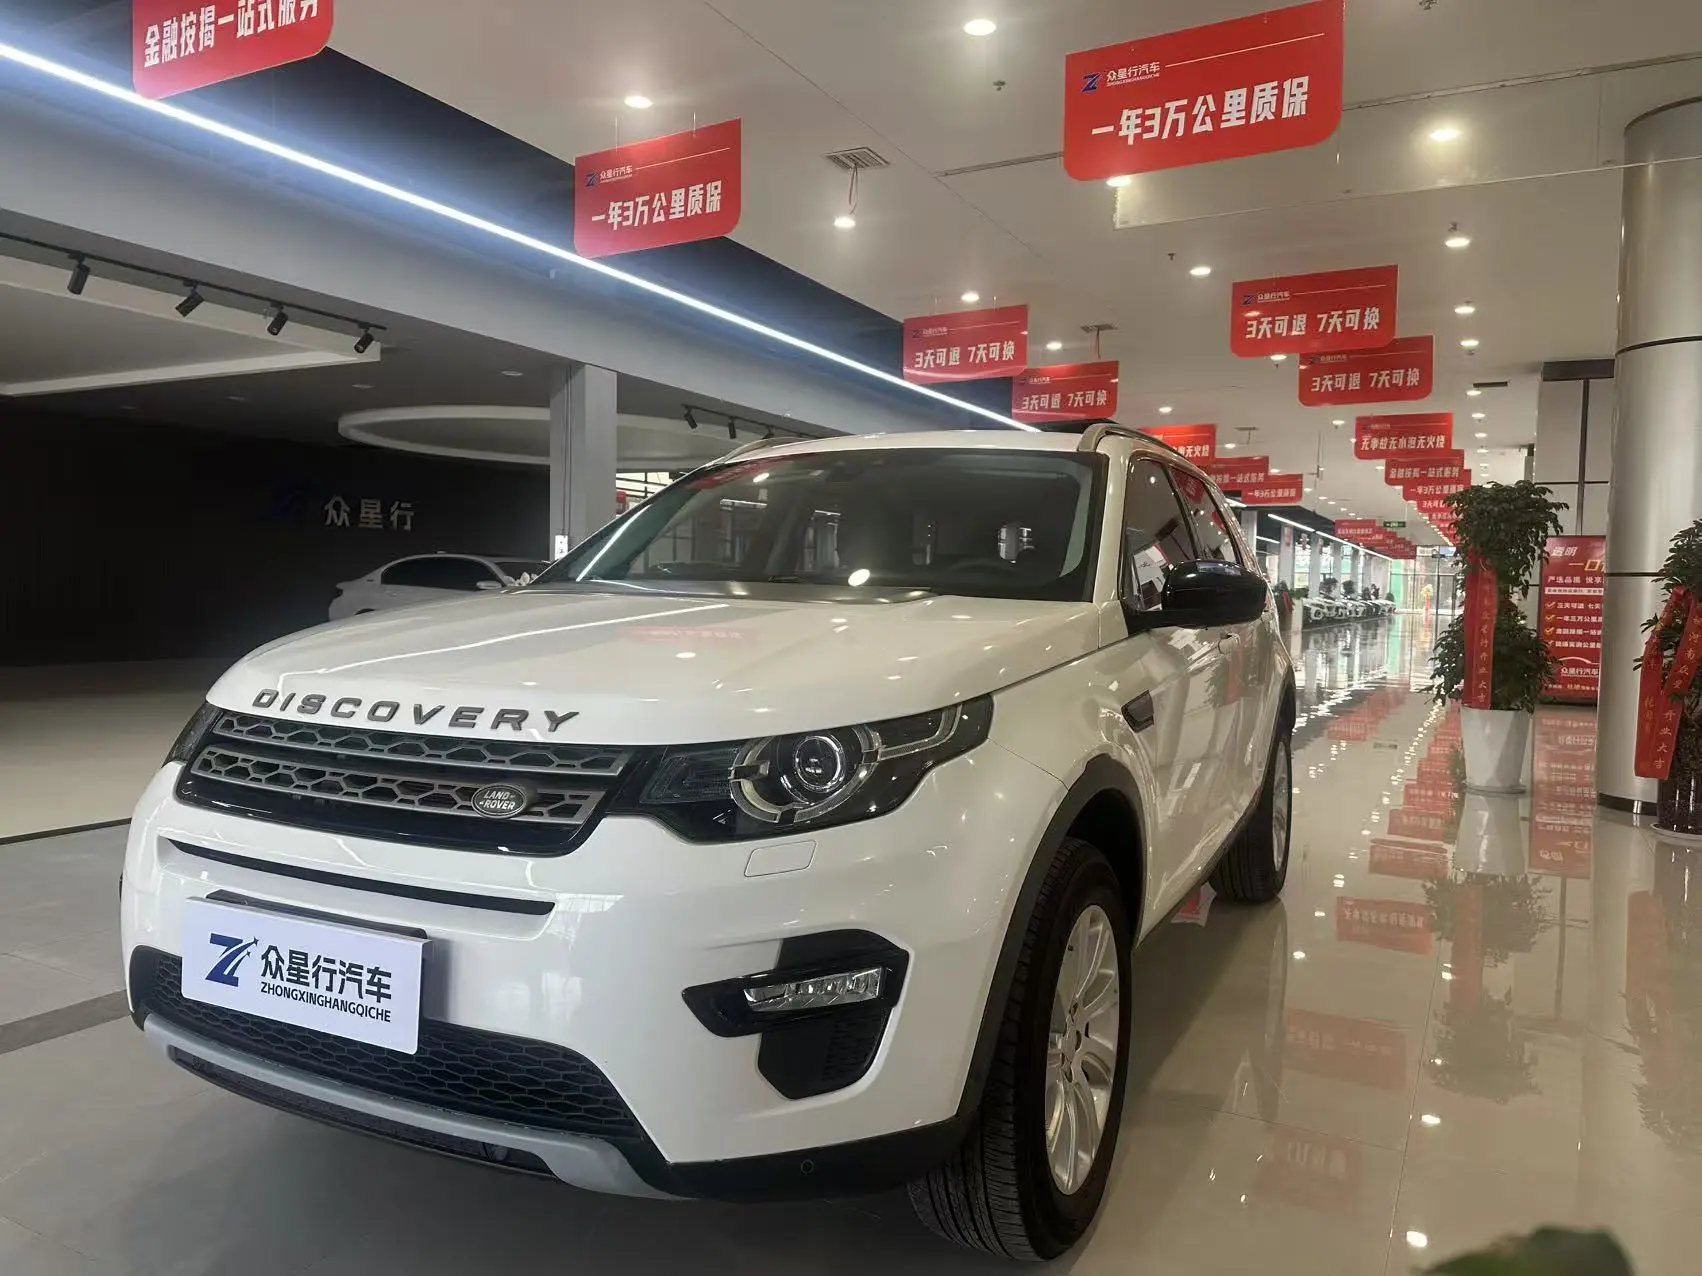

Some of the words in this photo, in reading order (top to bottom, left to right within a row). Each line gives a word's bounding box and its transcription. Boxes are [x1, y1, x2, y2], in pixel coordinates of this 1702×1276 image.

[1106, 61, 1160, 82] 众星行汽车
[1091, 76, 1309, 145] 一年3万公里质保
[599, 165, 633, 180] 众星行汽车
[591, 181, 722, 230] 一年3万公里质保
[1245, 313, 1307, 339] 3天可退
[1316, 306, 1380, 333] 7天可换
[914, 346, 961, 368] 3天可退
[967, 341, 1015, 363] 7天可换
[1311, 372, 1361, 392] 3天可退
[1369, 368, 1420, 387] 7天可换
[1021, 393, 1061, 411] 3天可退
[1067, 389, 1108, 408] 7天可换
[324, 495, 414, 531] 众星行
[1585, 576, 1604, 584] 悦享
[252, 688, 579, 732] DISCOVERY
[483, 790, 510, 800] LAND
[483, 799, 515, 810] ROVER
[261, 944, 391, 1003] 众星行汽车
[260, 981, 391, 1023] ZHONGXINGHANGQICHE
